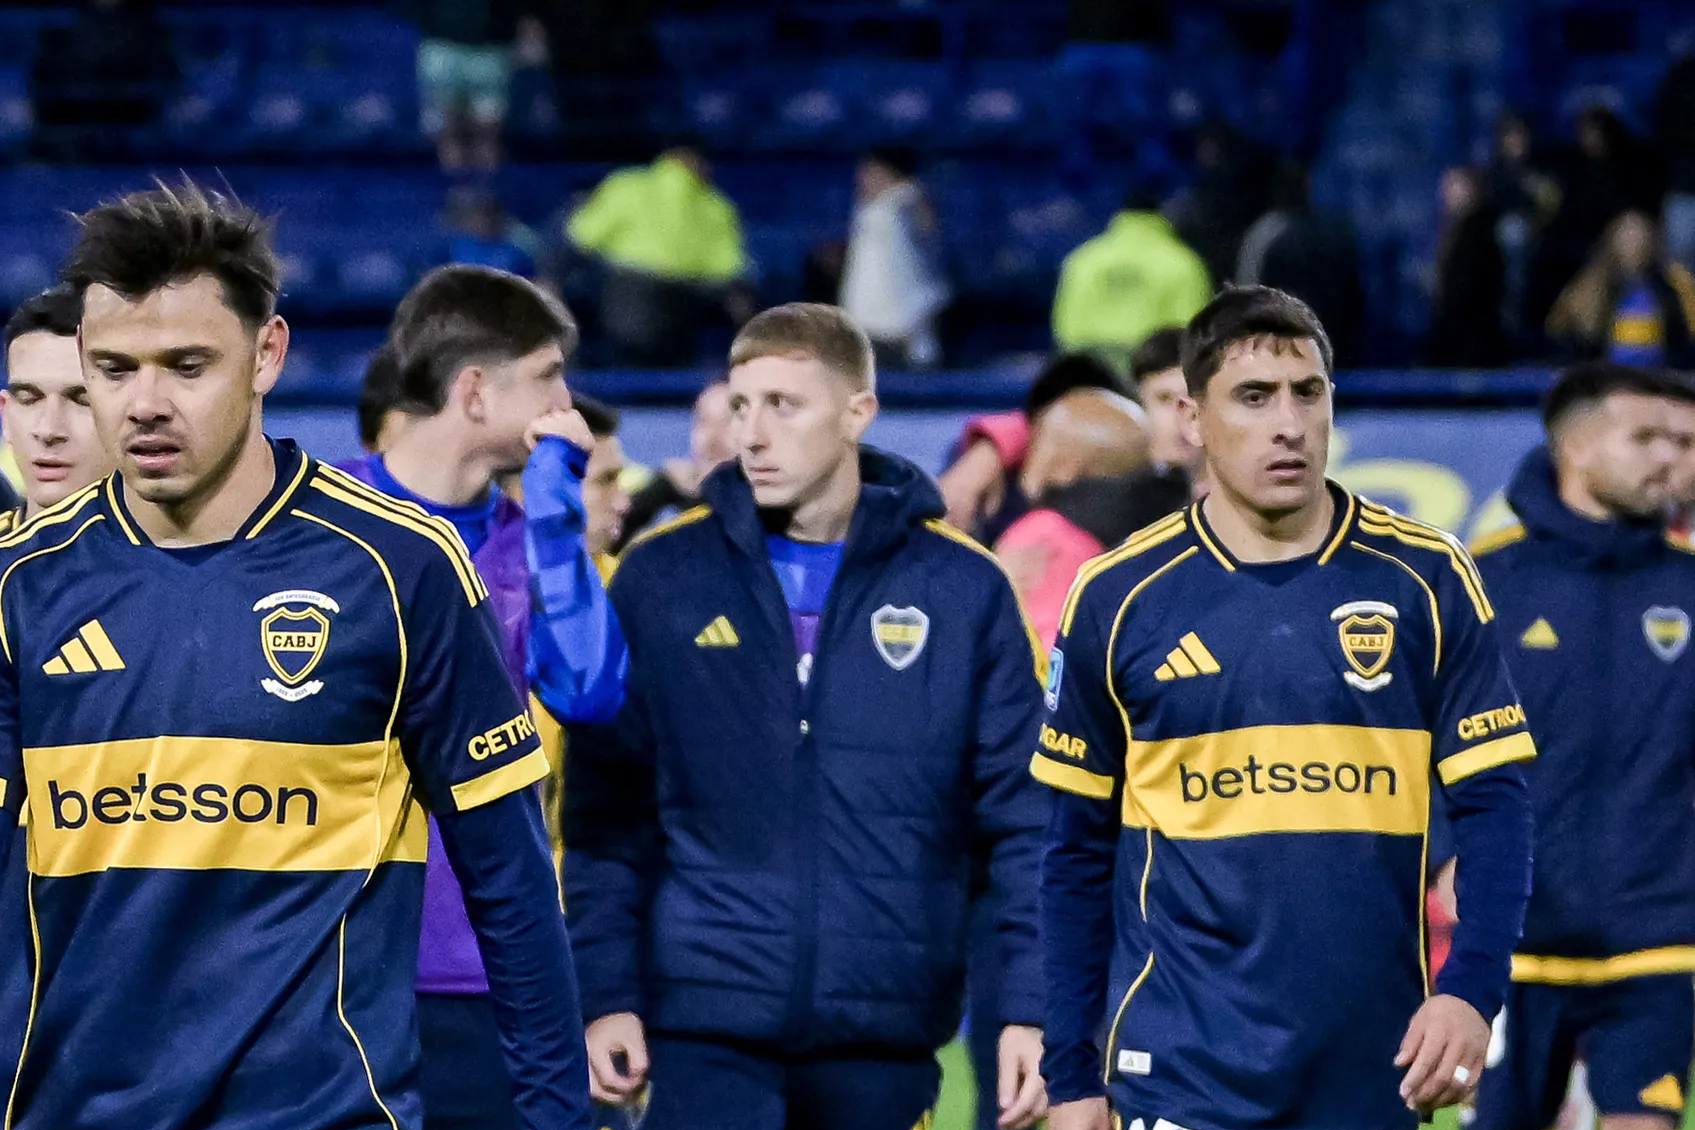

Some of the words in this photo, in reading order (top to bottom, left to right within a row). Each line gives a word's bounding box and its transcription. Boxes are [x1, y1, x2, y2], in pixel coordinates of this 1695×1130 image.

[272, 635, 316, 648] CABJ
[1040, 722, 1087, 759] GAR
[1179, 754, 1397, 803] betsson
[48, 773, 318, 830] betsson
